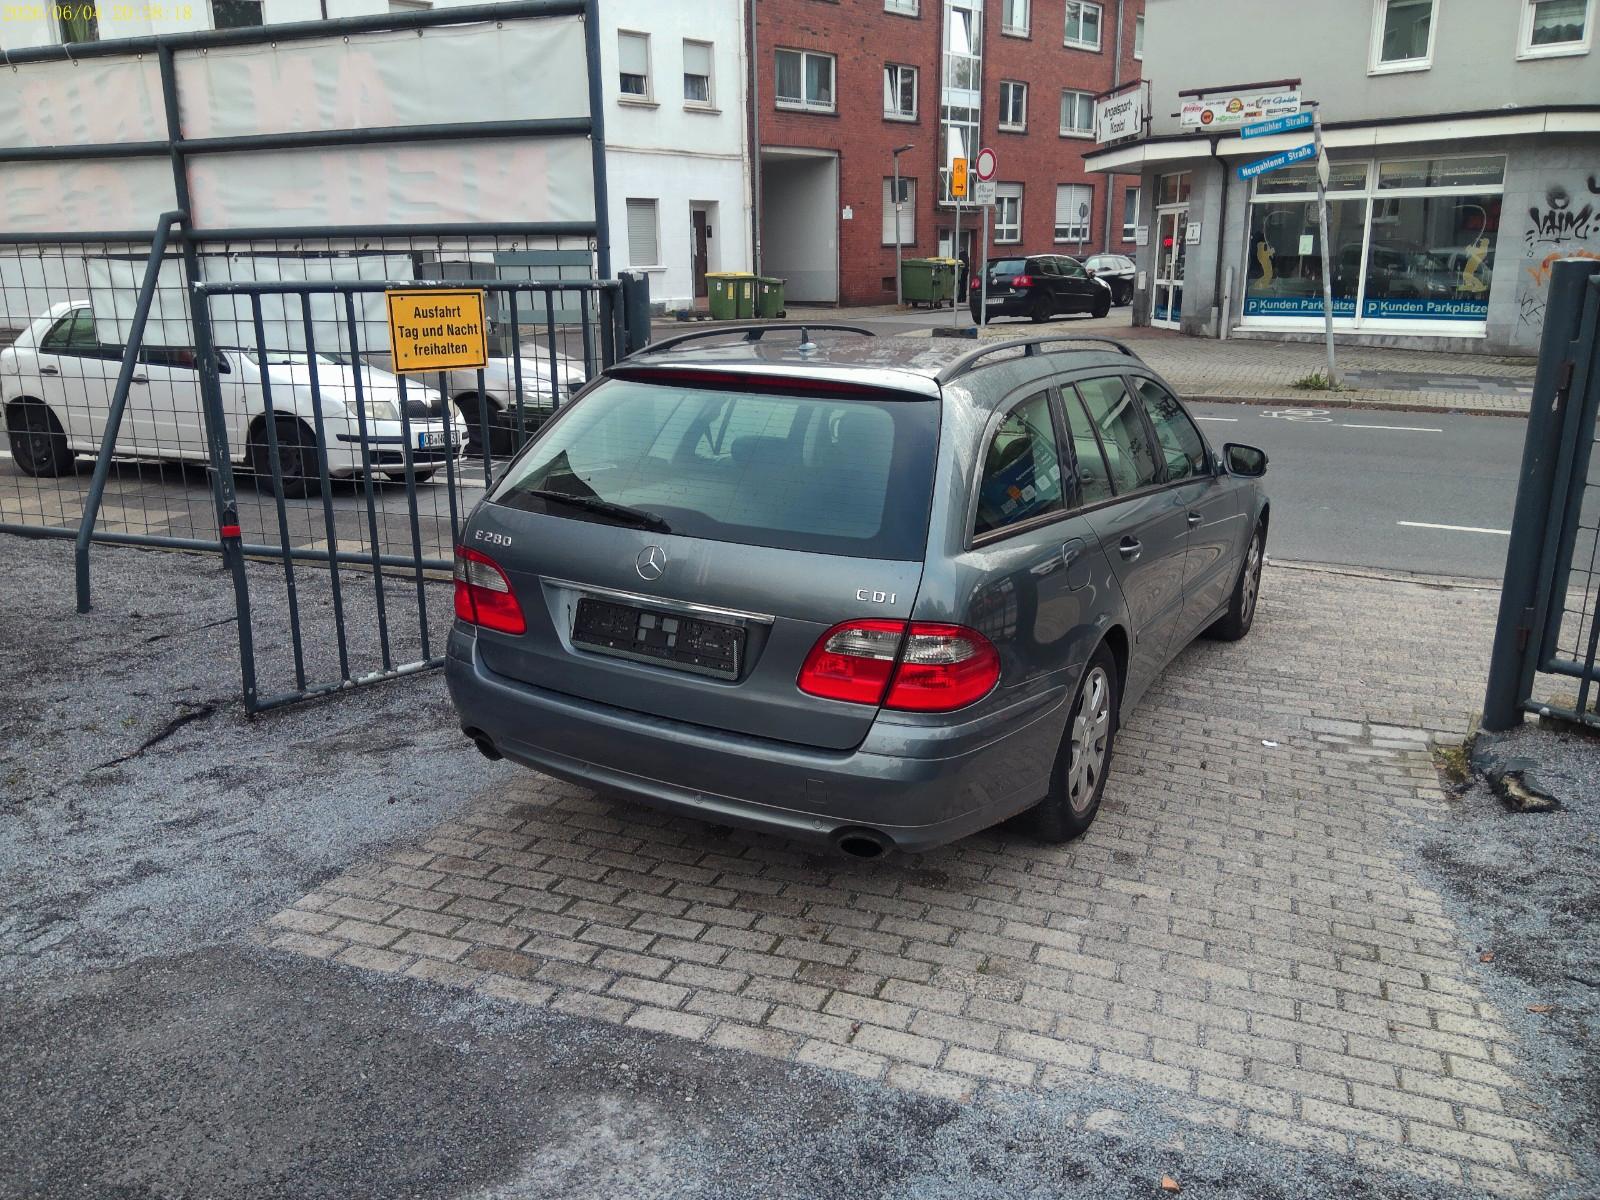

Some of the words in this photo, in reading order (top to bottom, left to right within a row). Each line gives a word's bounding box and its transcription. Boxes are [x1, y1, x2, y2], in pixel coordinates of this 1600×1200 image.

[1245, 122, 1282, 136] Neumühler
[1285, 114, 1309, 127] Straße
[1242, 155, 1285, 177] Neugahlener
[1287, 147, 1311, 161] Straße
[414, 305, 461, 319] Ausfahrt
[1260, 300, 1298, 310] Kunden
[1301, 301, 1355, 311] Parklätze
[1380, 301, 1424, 312] Kunden
[1427, 302, 1488, 315] Parkplätze
[398, 325, 419, 340] Tag
[422, 324, 443, 337] und
[447, 323, 479, 336] Nacht
[414, 342, 468, 356] freihalten
[475, 529, 512, 547] E280
[856, 588, 897, 605] CDI
